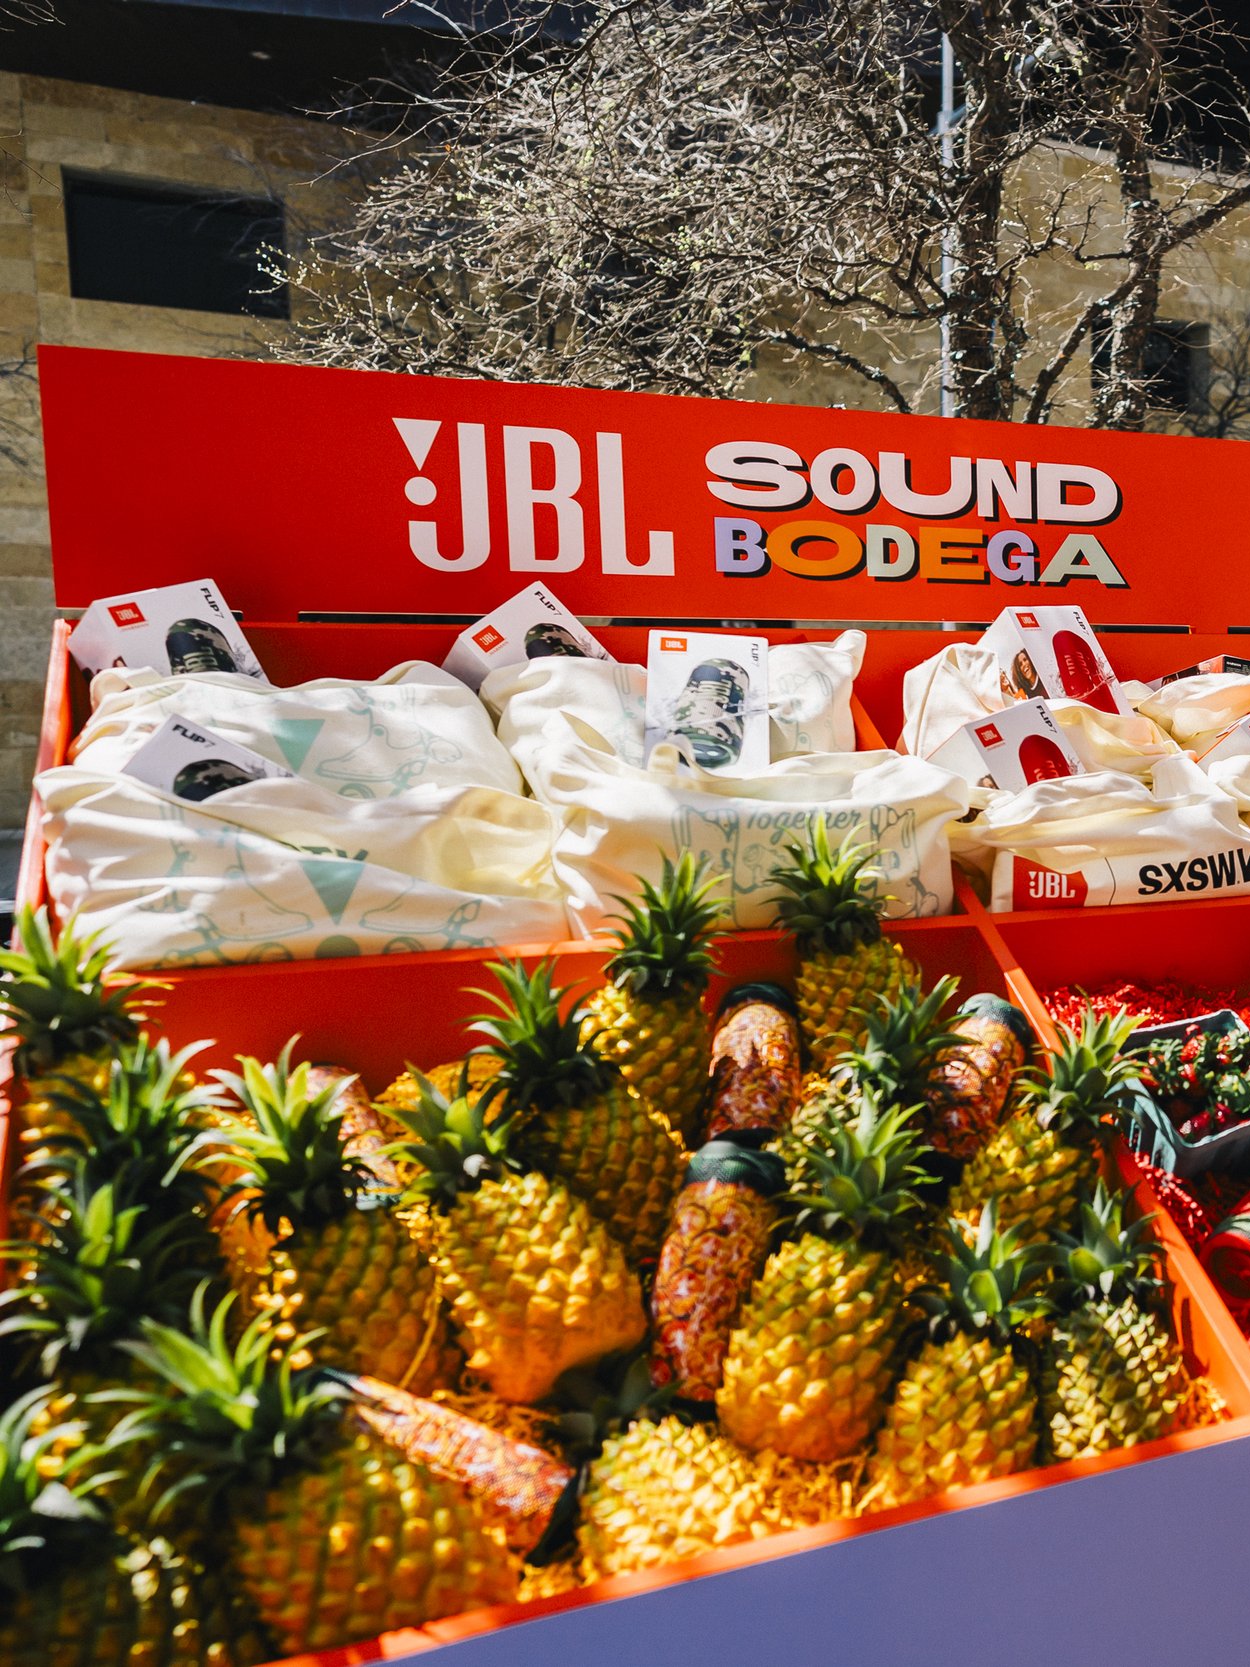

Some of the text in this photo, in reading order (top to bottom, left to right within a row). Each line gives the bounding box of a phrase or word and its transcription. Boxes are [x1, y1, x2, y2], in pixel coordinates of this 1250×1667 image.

[392, 417, 675, 577] JBL
[705, 441, 1122, 526] SOUND
[714, 515, 1131, 590] BODEGA
[115, 608, 140, 622] JBL
[479, 632, 498, 646] JBL
[1029, 848, 1236, 899] JBL SXSW
